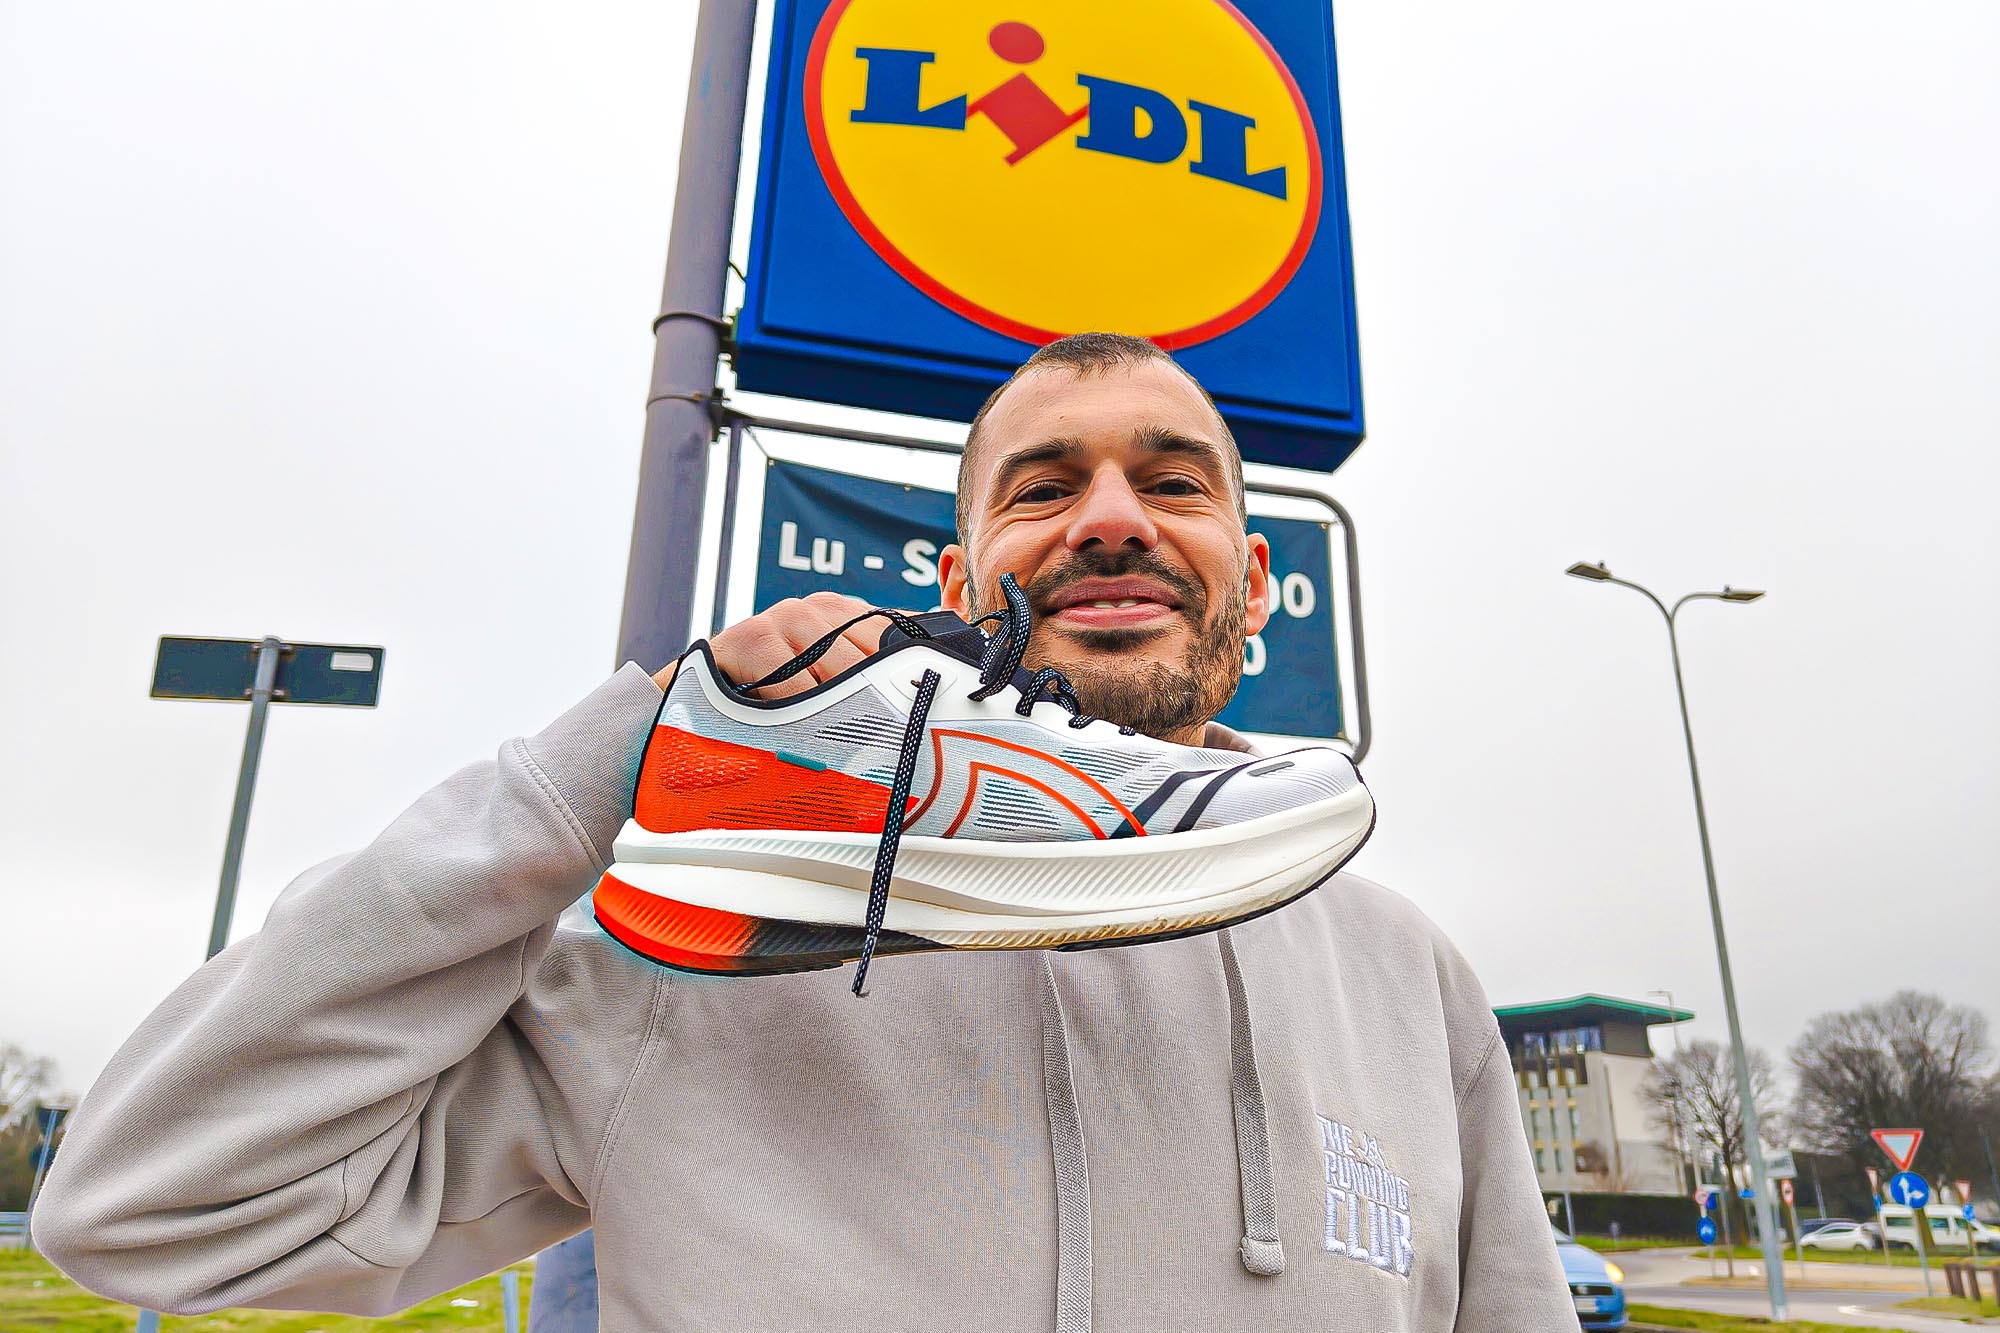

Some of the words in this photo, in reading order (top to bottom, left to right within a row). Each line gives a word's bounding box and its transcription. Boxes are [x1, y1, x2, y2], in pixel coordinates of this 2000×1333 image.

[778, 520, 845, 576] Lu
[863, 555, 884, 570] -
[901, 538, 942, 587] S
[1315, 1113, 1355, 1157] THE
[1323, 1150, 1410, 1212] RUNNING
[1323, 1186, 1415, 1277] CLUB
